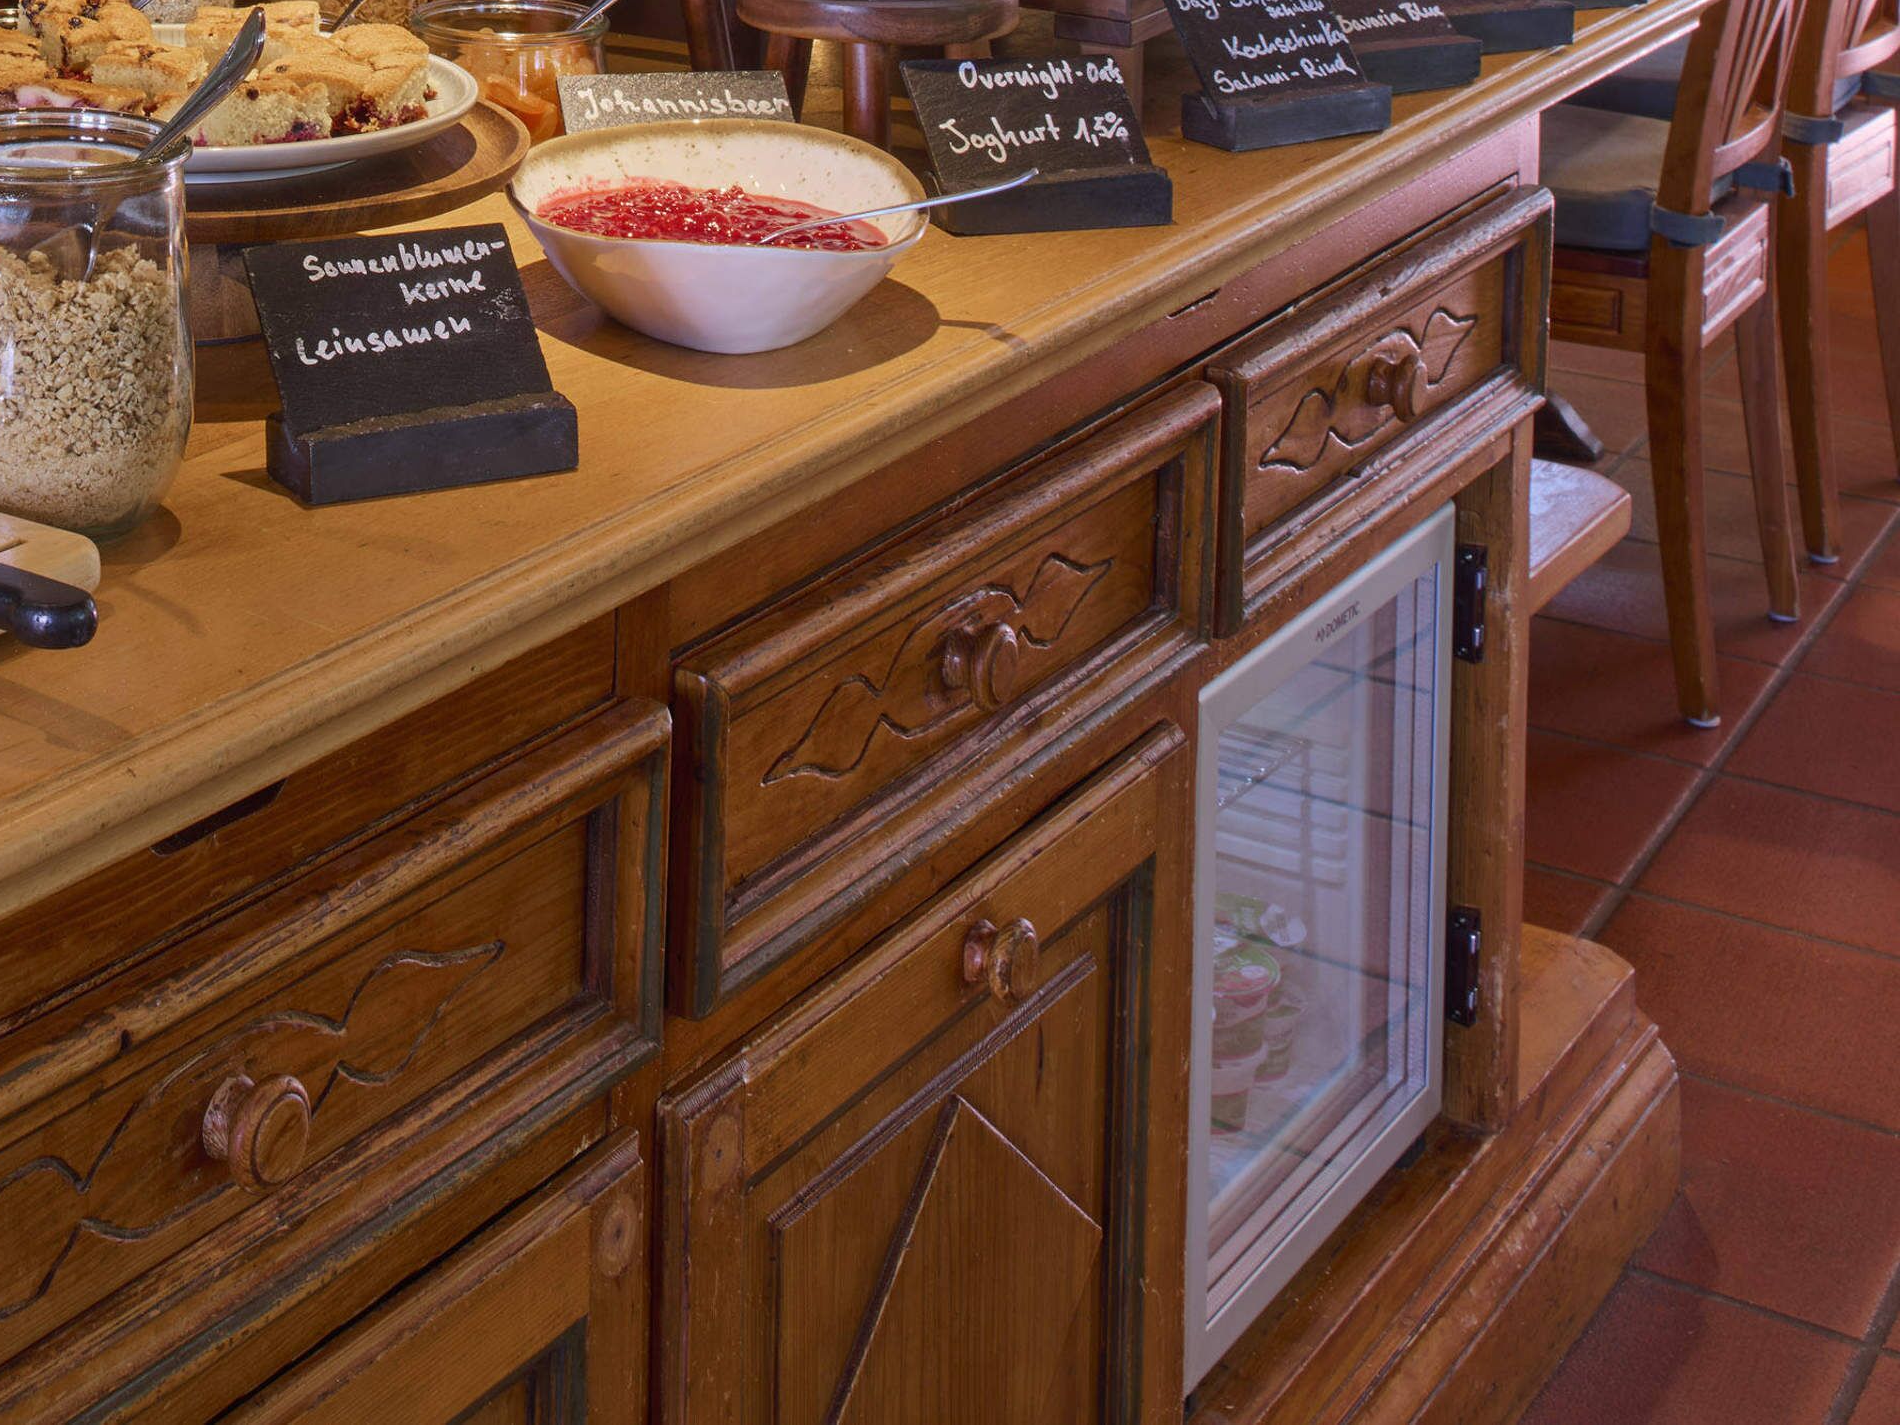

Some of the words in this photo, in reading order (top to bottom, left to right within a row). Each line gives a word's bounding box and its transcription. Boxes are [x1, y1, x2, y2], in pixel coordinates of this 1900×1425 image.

[1398, 2, 1445, 21] Blue
[958, 58, 1124, 100] Overnight-Oats
[1214, 52, 1357, 93] Salami-Rind
[577, 89, 789, 120] Johannisbeer
[939, 113, 1060, 163] Joghurt
[1074, 111, 1129, 147] 1,5%
[303, 240, 505, 282] Sonnenblumen-
[296, 316, 472, 365] Leinsamen
